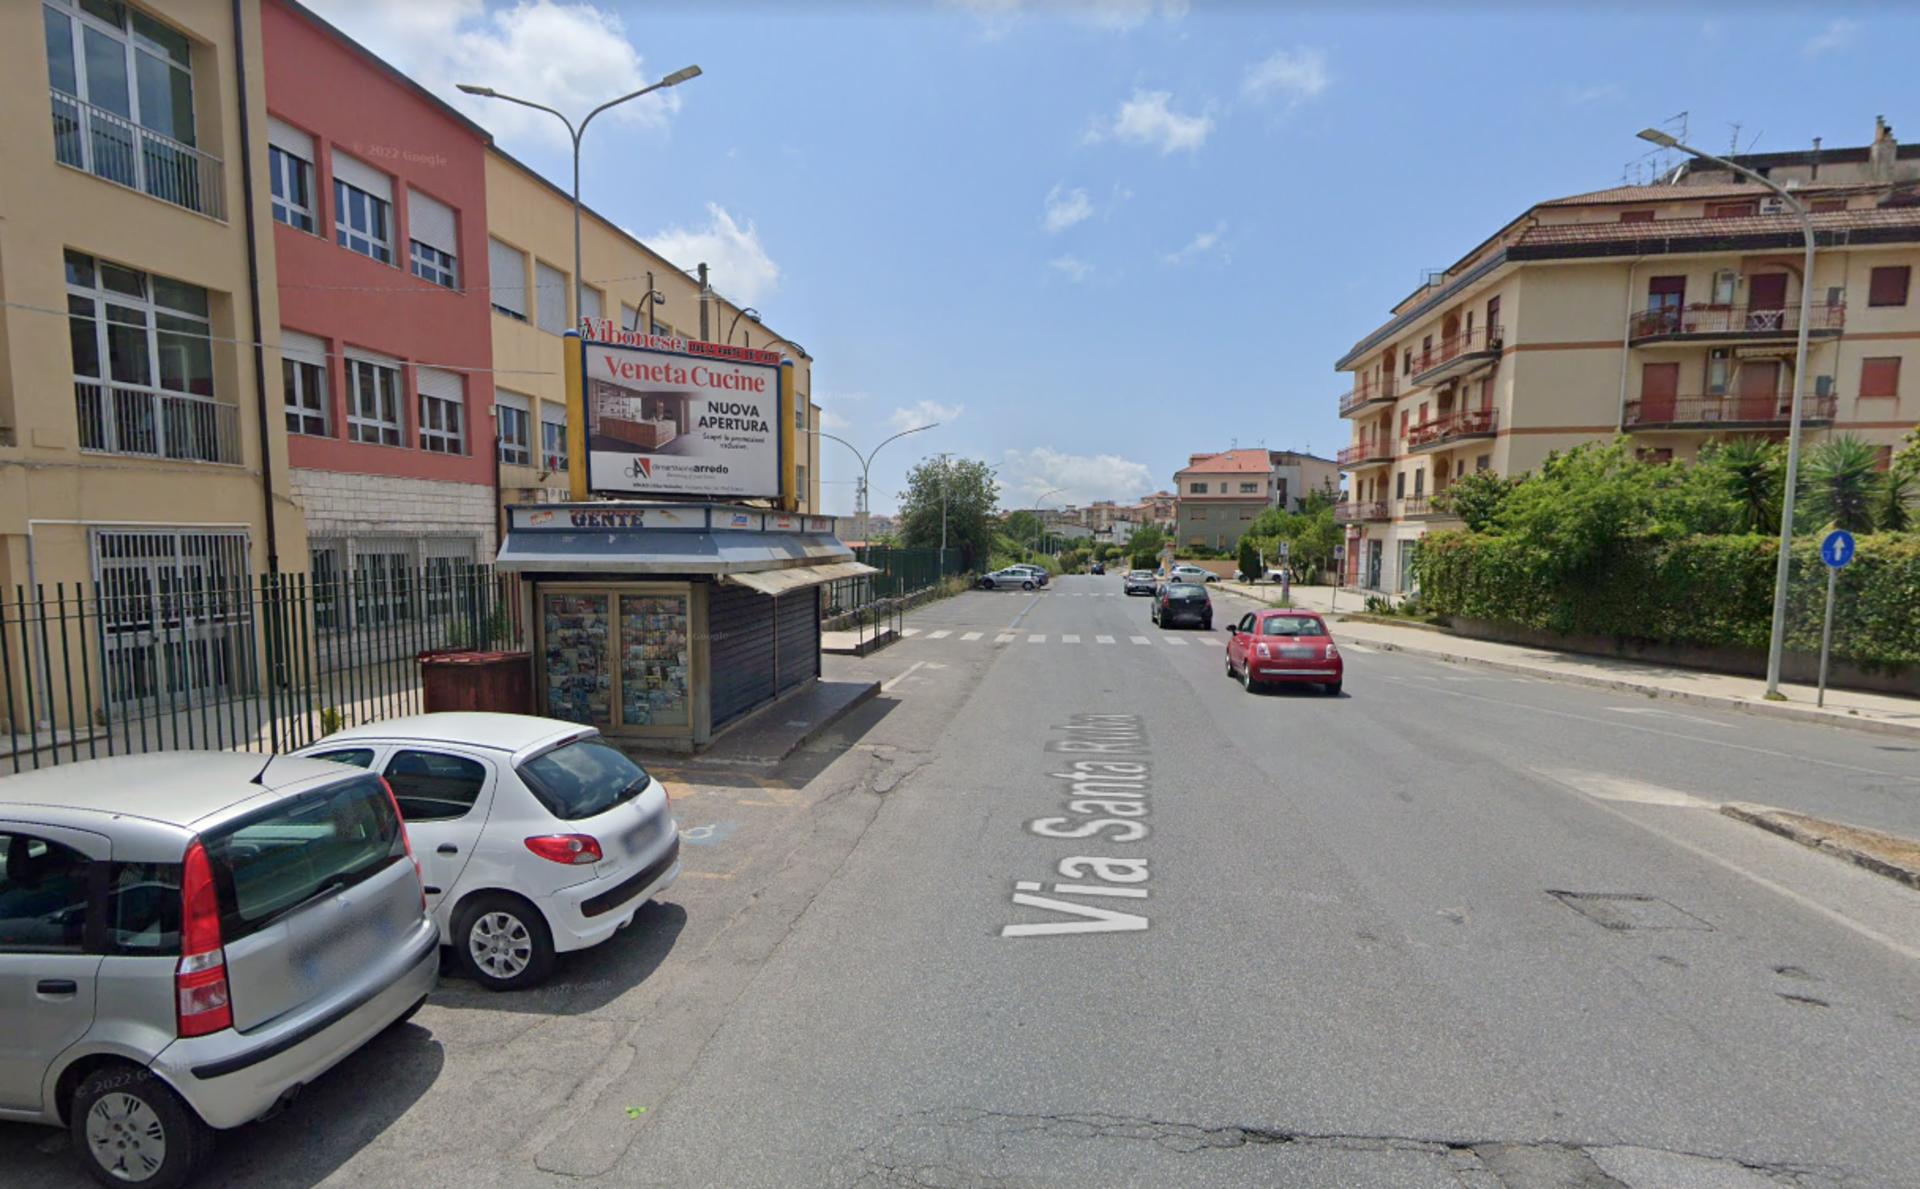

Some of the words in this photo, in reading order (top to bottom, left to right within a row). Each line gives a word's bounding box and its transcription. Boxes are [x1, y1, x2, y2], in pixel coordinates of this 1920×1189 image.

[604, 355, 687, 385] Veneta
[691, 365, 765, 393] Cucine
[708, 401, 760, 418] NUOVA
[698, 416, 769, 433] APERTURA
[569, 509, 645, 527] GENTE
